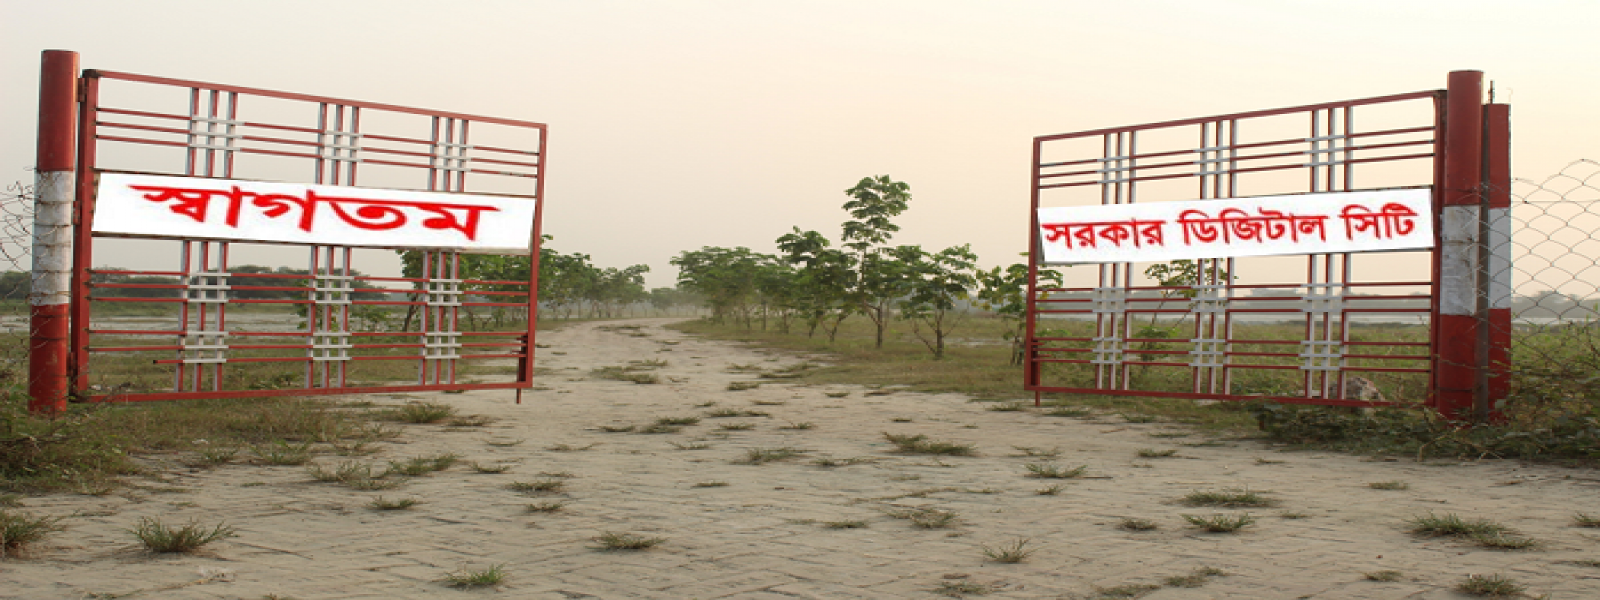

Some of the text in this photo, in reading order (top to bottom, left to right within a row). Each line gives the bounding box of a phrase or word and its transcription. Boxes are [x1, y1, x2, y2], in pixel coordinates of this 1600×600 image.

[128, 184, 501, 241] স্বাগতম
[1042, 202, 1418, 249] সরকার ডিজিটাল সিটি
